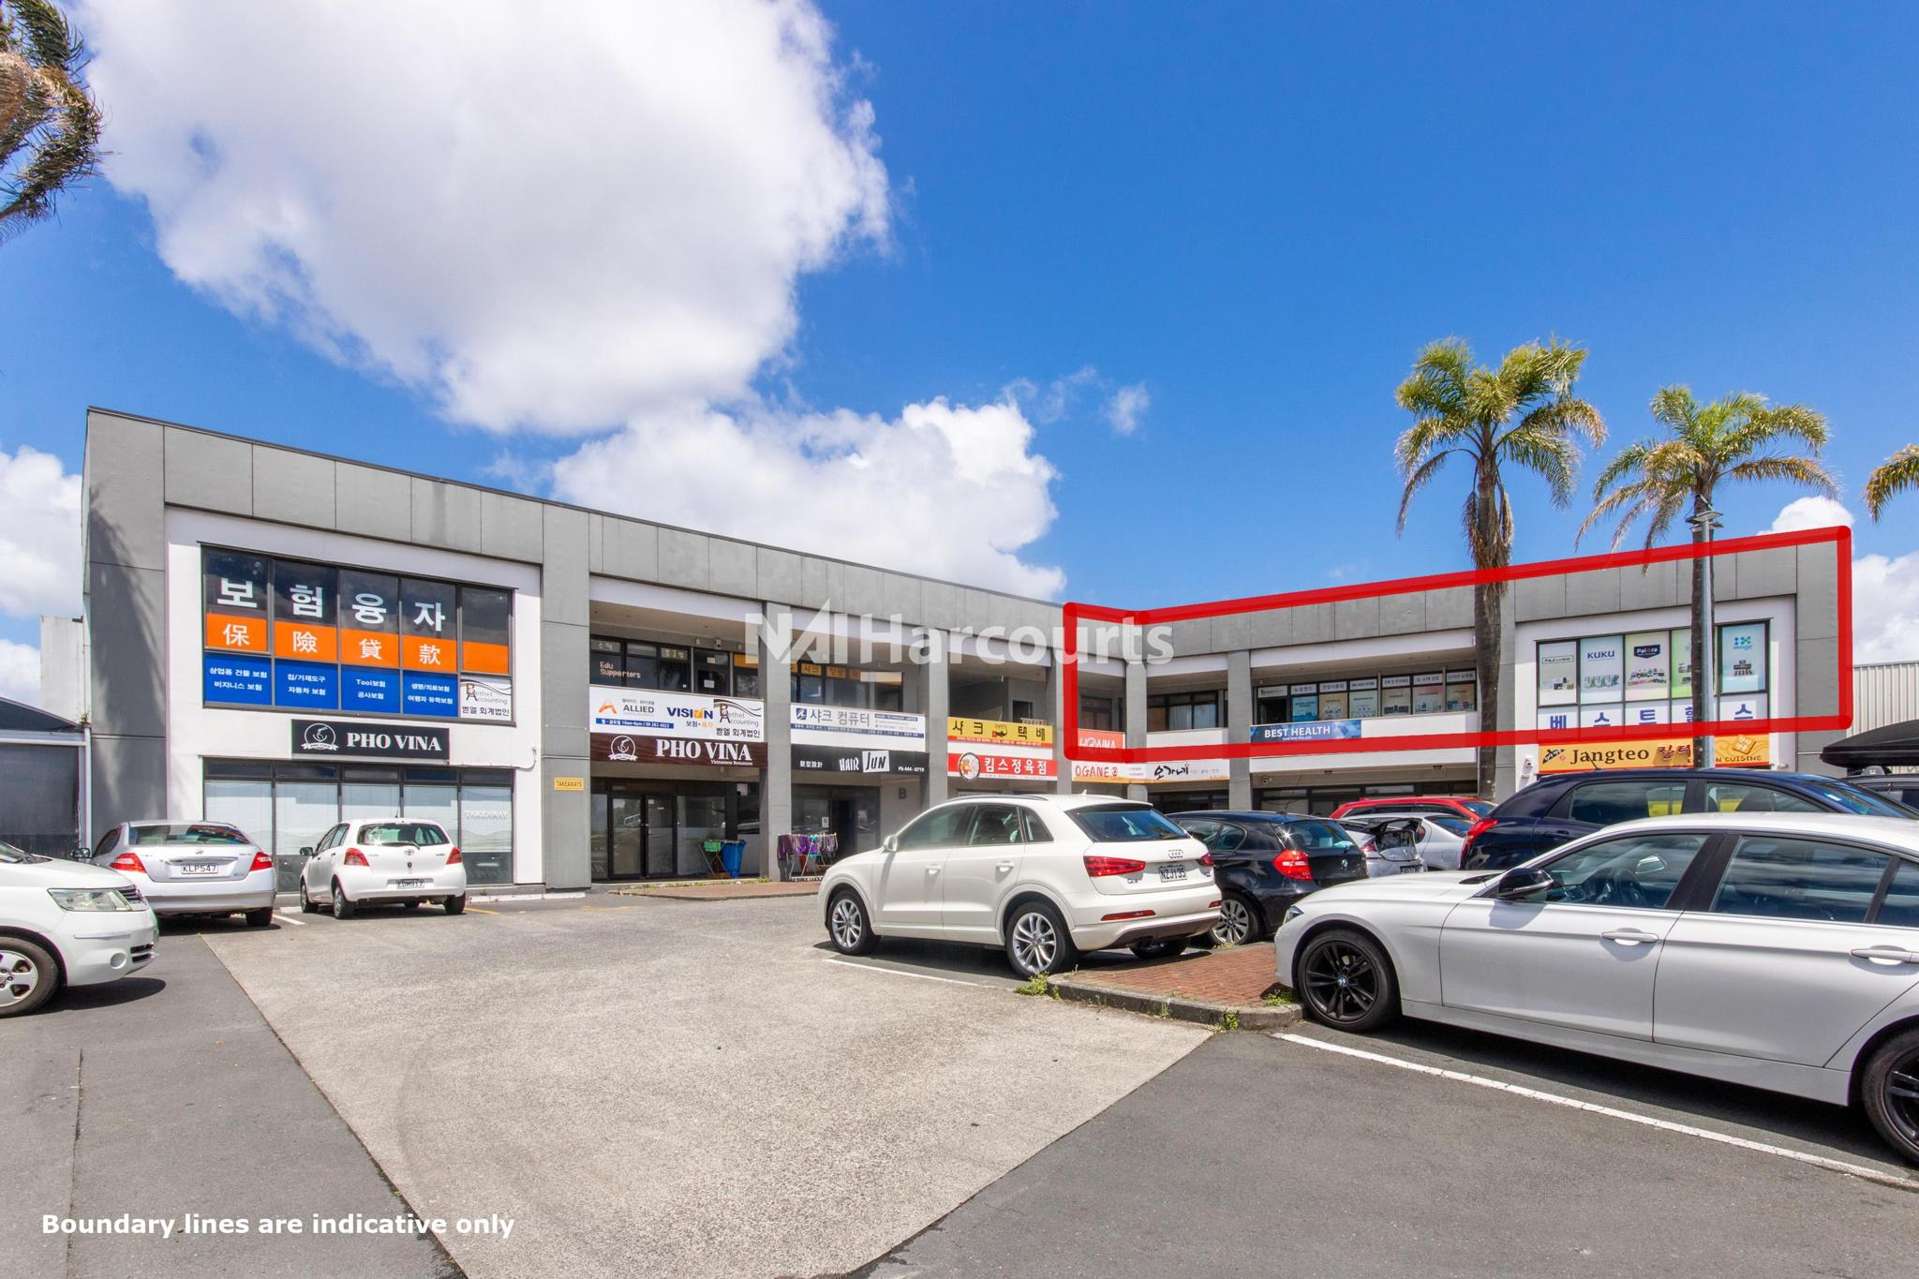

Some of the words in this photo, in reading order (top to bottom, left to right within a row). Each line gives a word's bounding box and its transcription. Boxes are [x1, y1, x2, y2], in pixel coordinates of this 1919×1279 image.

[1586, 650, 1616, 660] KUKU
[599, 661, 614, 669] Edu
[599, 668, 641, 679] Supporters
[623, 704, 655, 714] ALLIED
[810, 708, 833, 723] 샤크
[838, 711, 870, 728] 컴퓨터
[1264, 728, 1289, 738] BEST
[1291, 726, 1331, 737] HEALTH
[346, 732, 392, 749] PHO
[394, 734, 443, 752] VINA
[656, 738, 701, 759] PHO
[704, 741, 753, 761] VINA
[839, 756, 860, 772] HAIR
[865, 751, 887, 771] JUN
[1569, 747, 1650, 765] Jangteo
[984, 757, 1047, 776] 킴스정육점
